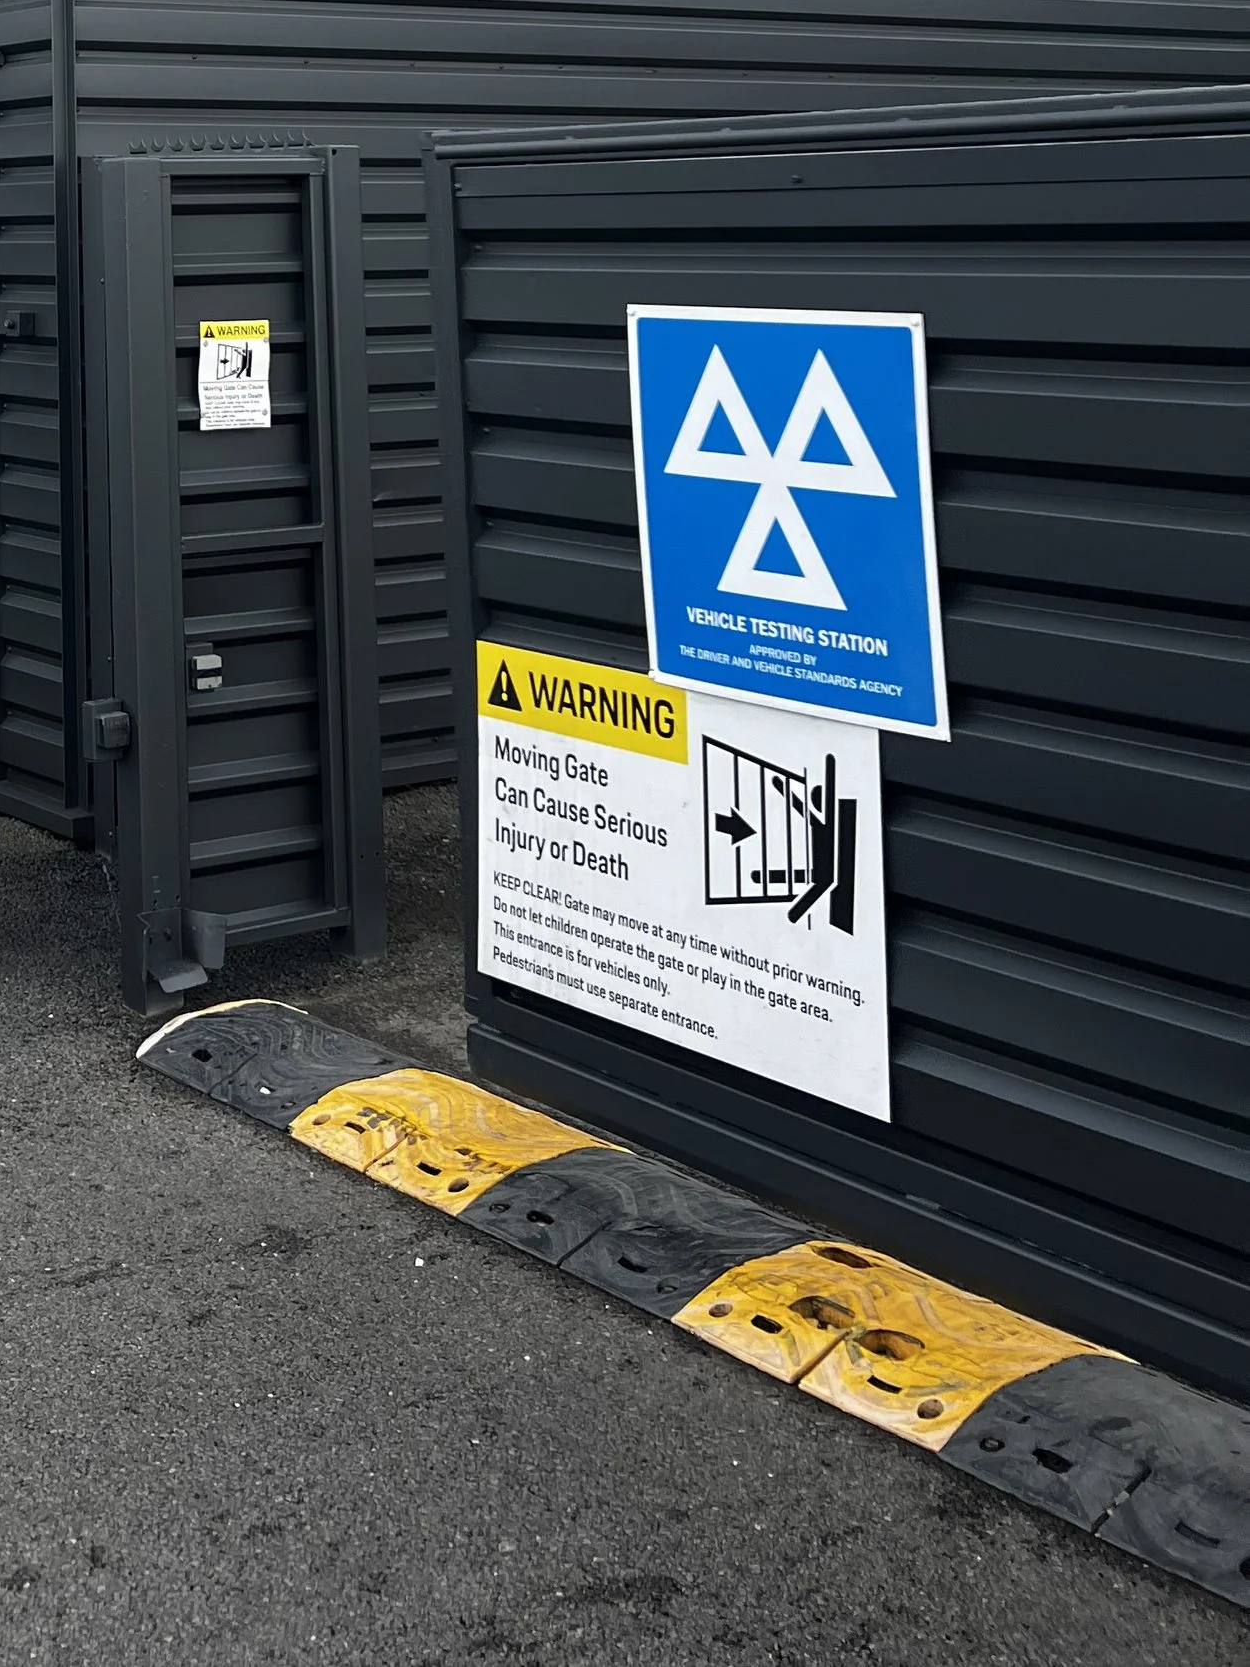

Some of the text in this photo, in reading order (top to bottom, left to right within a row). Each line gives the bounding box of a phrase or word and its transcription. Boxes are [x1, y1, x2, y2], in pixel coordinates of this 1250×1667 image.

[217, 325, 266, 336] WARNING
[686, 606, 888, 656] VEHICLE TESTING STATION
[750, 644, 817, 666] APPROVED BY
[679, 644, 904, 696] THE DRIVER AND VEHICLE STANDARDS AGENCY
[528, 671, 675, 739] WARNING
[495, 735, 608, 787] Moving Gate
[495, 777, 668, 847] Can Cause Serious
[495, 818, 629, 880] Injury or Death
[494, 870, 865, 1006] KEEP CLEAR! Gate may move at any time without prior warning.
[494, 920, 670, 997] This entrance is for vehicles only.
[494, 896, 832, 1022] Do not let children operate the gate or play in the gate area.
[493, 946, 718, 1040] Pedestrians must use separate entrance.
